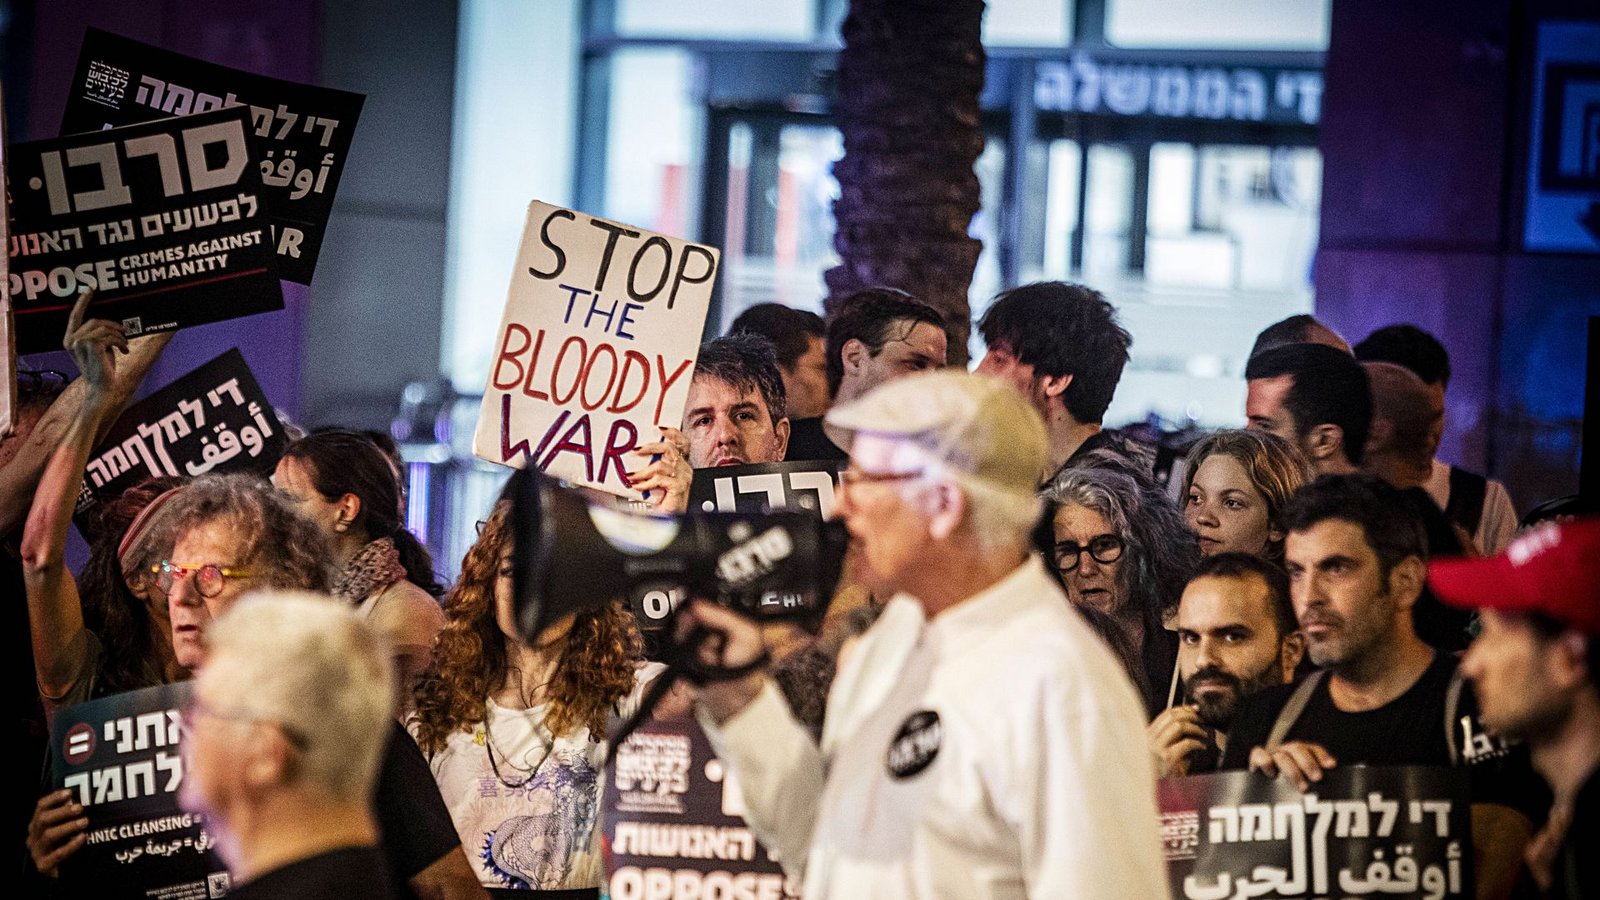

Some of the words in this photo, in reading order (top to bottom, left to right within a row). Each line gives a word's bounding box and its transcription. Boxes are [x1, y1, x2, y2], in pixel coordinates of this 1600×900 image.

[85, 78, 125, 99] בעיניים
[88, 69, 128, 88] לכיבוש
[134, 73, 299, 141] למחמה
[302, 114, 340, 148] די
[88, 221, 136, 246] נגד
[141, 192, 259, 239] לפשעים
[119, 246, 185, 269] CRIMES
[187, 230, 262, 257] AGAINST
[528, 208, 716, 310] STOP
[10, 259, 119, 301] PPOSE
[122, 253, 229, 287] HUMANITY
[559, 283, 645, 340] THE
[206, 377, 246, 408] די
[493, 323, 693, 426] BLOODY
[86, 398, 206, 488] למלחמה
[184, 400, 273, 477] أوقف
[63, 750, 184, 807] לחמה
[86, 829, 118, 846] HNIC
[119, 814, 193, 840] CLEANSING
[1208, 791, 1399, 884] למלחמה
[1408, 799, 1453, 838] די
[115, 846, 143, 864] حرب
[145, 837, 183, 858] جريمة
[1338, 841, 1462, 900] أوقف
